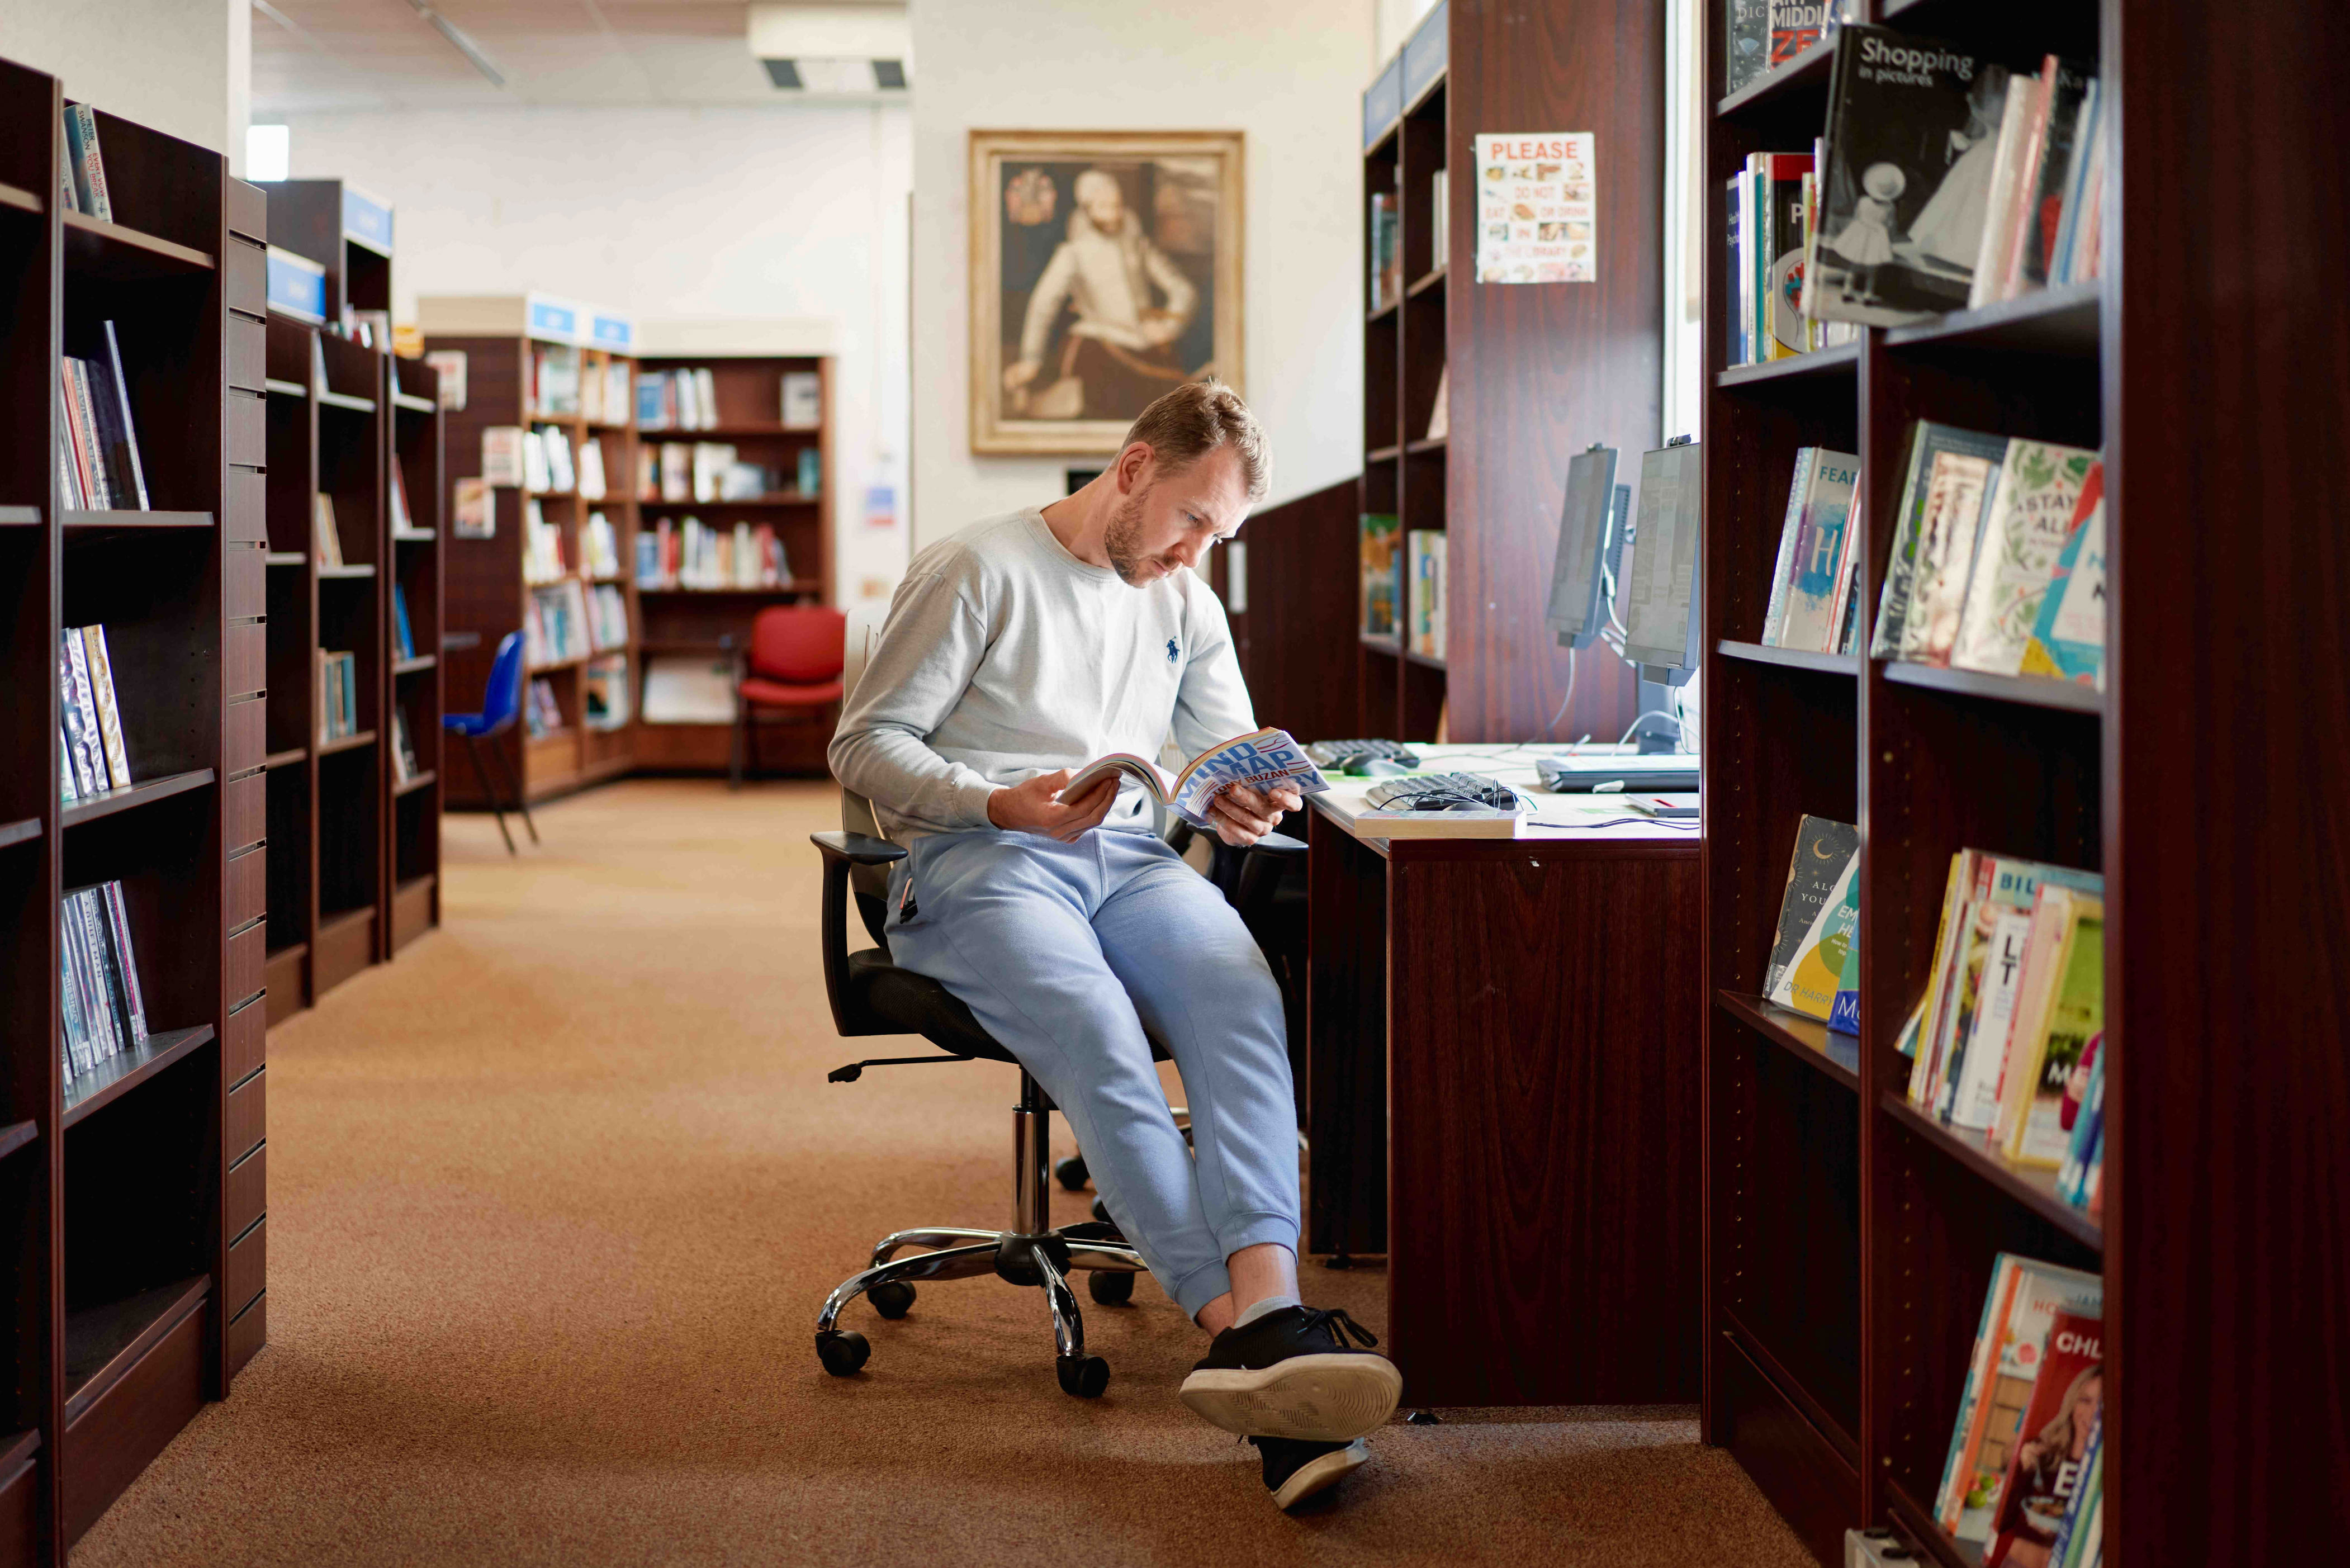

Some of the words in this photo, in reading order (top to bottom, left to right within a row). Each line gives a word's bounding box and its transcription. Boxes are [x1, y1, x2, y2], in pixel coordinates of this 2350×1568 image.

[1738, 6, 1768, 18] DIC
[1860, 36, 1974, 80] Shopping
[1858, 64, 1872, 78] in
[1876, 68, 1933, 87] pictures
[78, 111, 91, 150] SWANSON
[86, 119, 95, 140] PETER
[1491, 141, 1578, 160] PLEASE
[89, 173, 99, 198] BREAK
[93, 153, 101, 175] EVERY
[98, 178, 106, 197] VOW
[1177, 742, 1258, 807] MIND
[1212, 750, 1294, 784] MAP
[1211, 779, 1242, 796] TONY
[1244, 769, 1290, 784] BUZAN
[93, 951, 102, 978] MAN
[65, 972, 78, 1024] MISSING
[1784, 981, 1799, 994] DR
[1800, 987, 1834, 1006] HARRY
